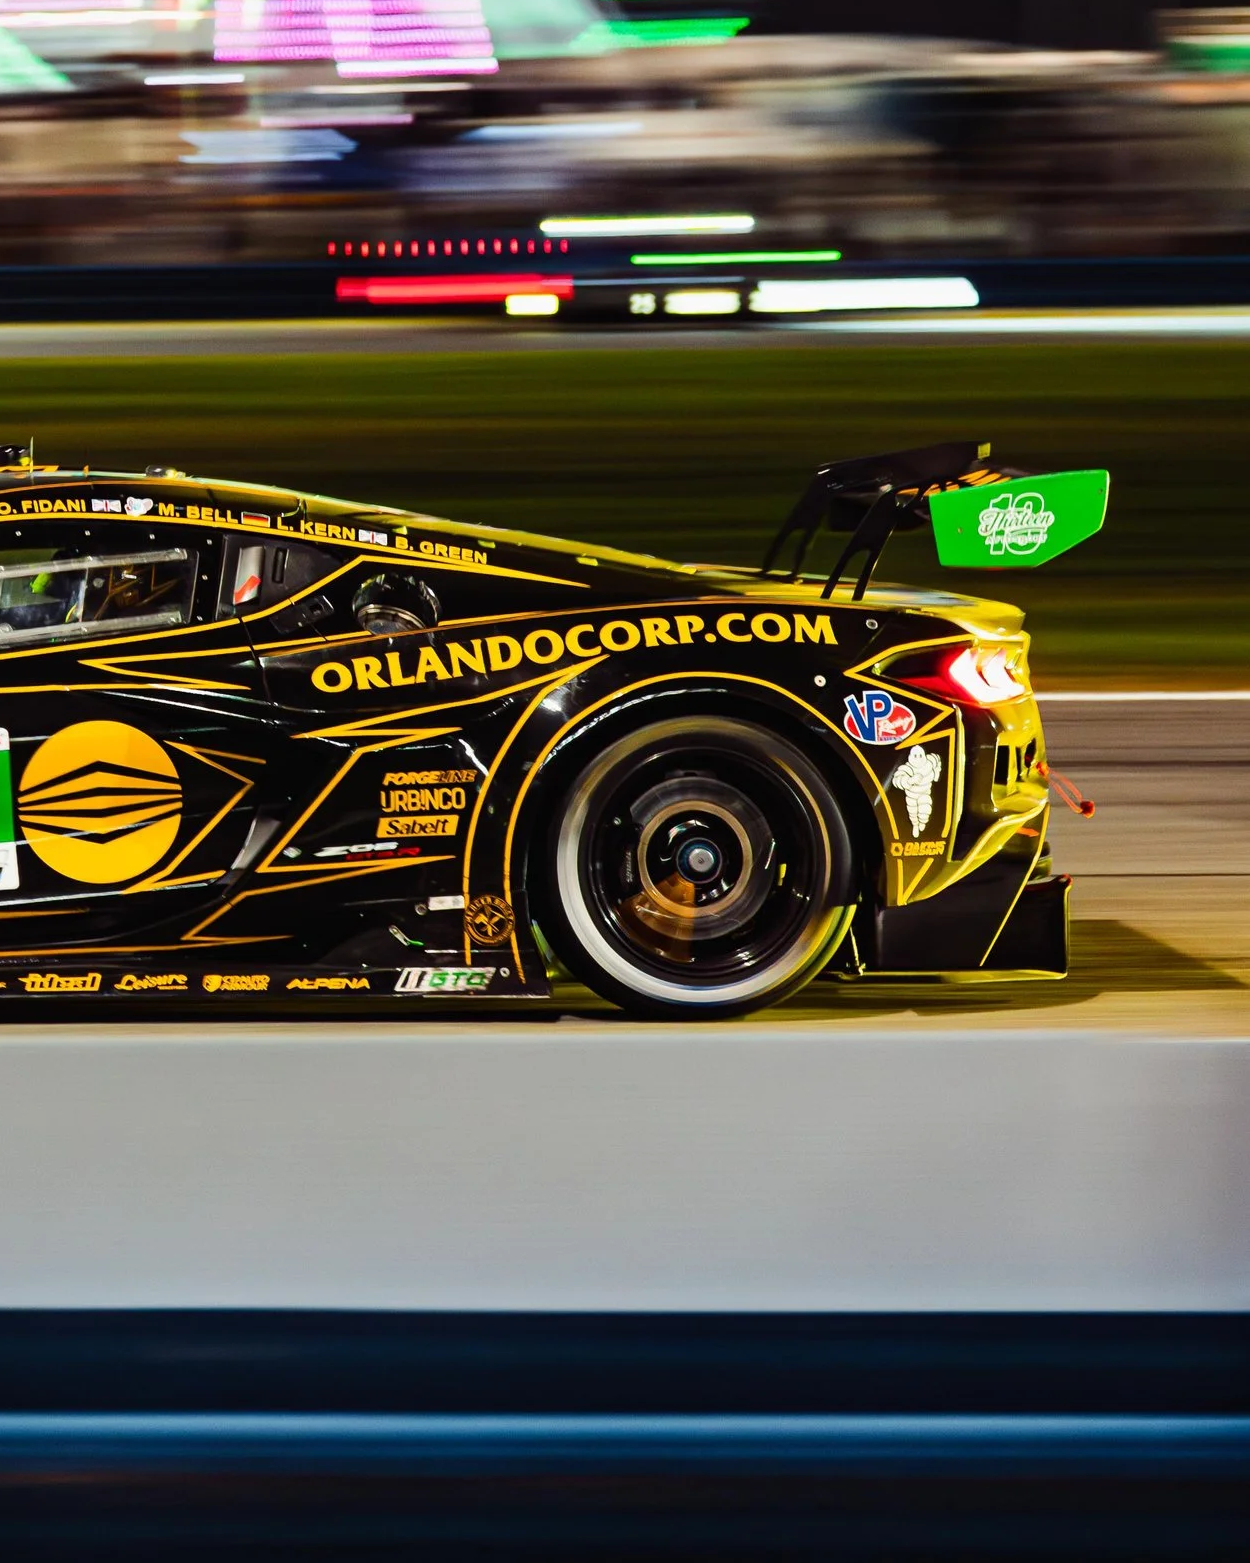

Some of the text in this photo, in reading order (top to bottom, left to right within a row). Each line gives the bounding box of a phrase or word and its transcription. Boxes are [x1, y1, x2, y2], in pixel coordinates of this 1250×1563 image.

[21, 499, 87, 514] FIDANI
[158, 502, 239, 524] M. BELL
[277, 516, 357, 541] L. KERN
[395, 536, 488, 565] B. GREEN
[311, 612, 839, 694] ORLANDOCORP.COM
[844, 690, 893, 742] VP
[382, 770, 478, 786] FORGELINE
[386, 819, 450, 836] Sabelt
